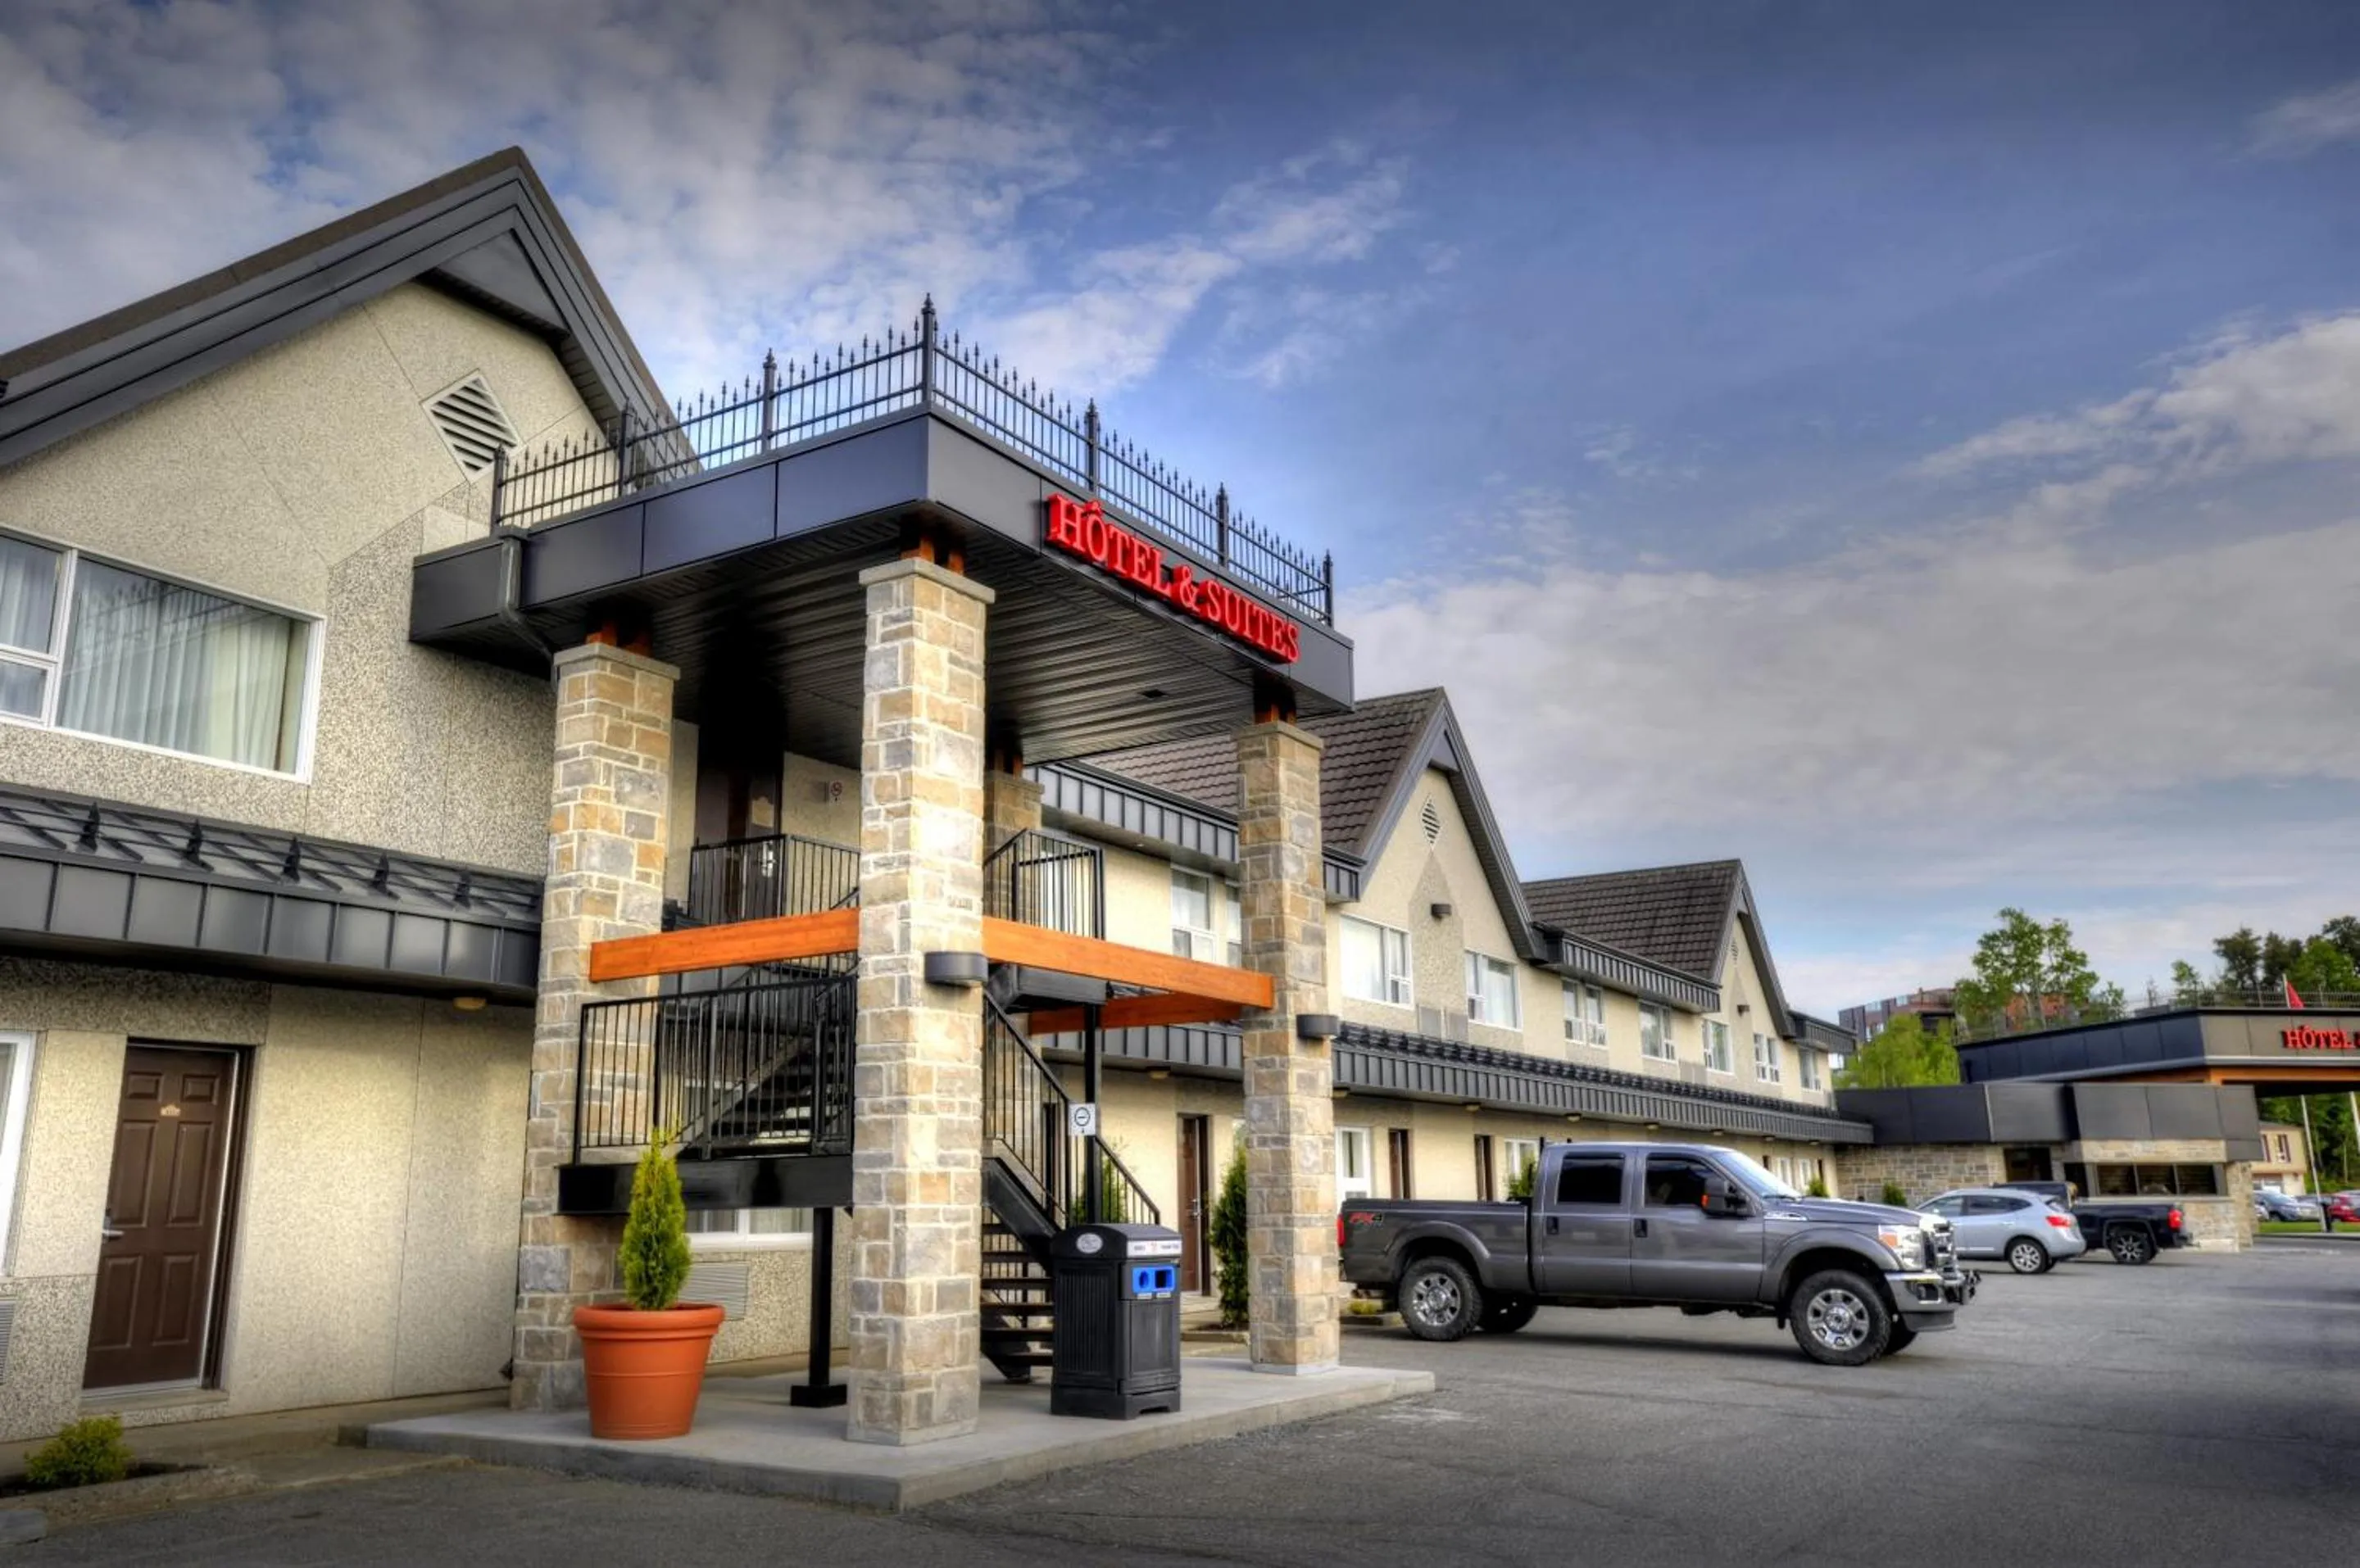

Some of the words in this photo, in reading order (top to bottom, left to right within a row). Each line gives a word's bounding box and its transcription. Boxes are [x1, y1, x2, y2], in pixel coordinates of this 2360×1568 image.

[1049, 493, 1172, 596] HÔTEL
[1174, 564, 1200, 613] &
[1200, 579, 1300, 663] SUITES
[2283, 1025, 2355, 1049] HÔTEL
